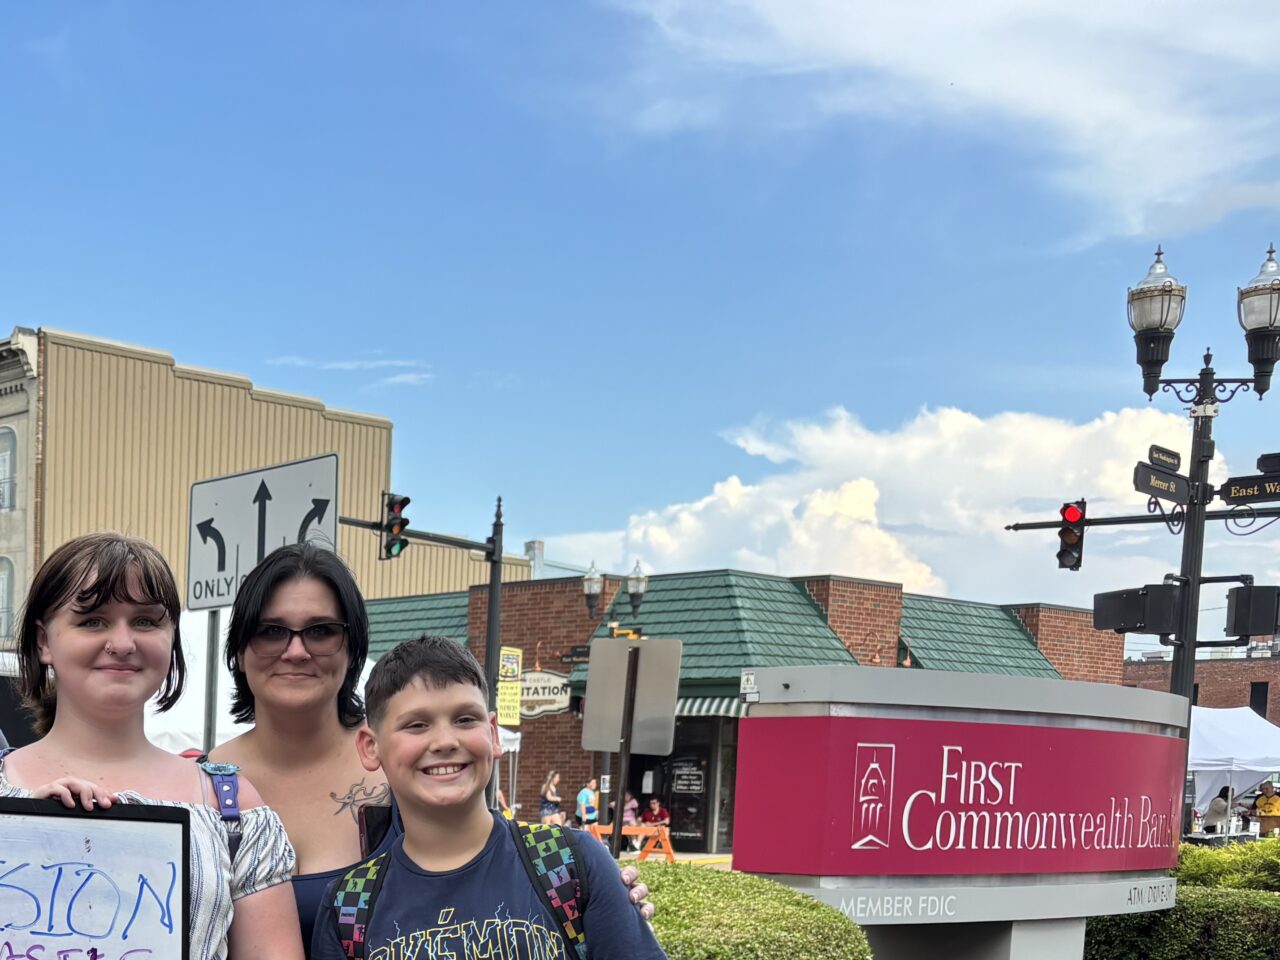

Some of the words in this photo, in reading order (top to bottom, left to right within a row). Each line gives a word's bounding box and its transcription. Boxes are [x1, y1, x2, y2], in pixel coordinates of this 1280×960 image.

[1150, 474, 1169, 490] Mercer
[1230, 485, 1260, 498] East
[193, 576, 235, 600] ONLY
[521, 685, 569, 697] ITATION
[902, 789, 1134, 851] Commonwealth
[840, 895, 913, 918] MEMBER
[918, 895, 957, 917] FDIC
